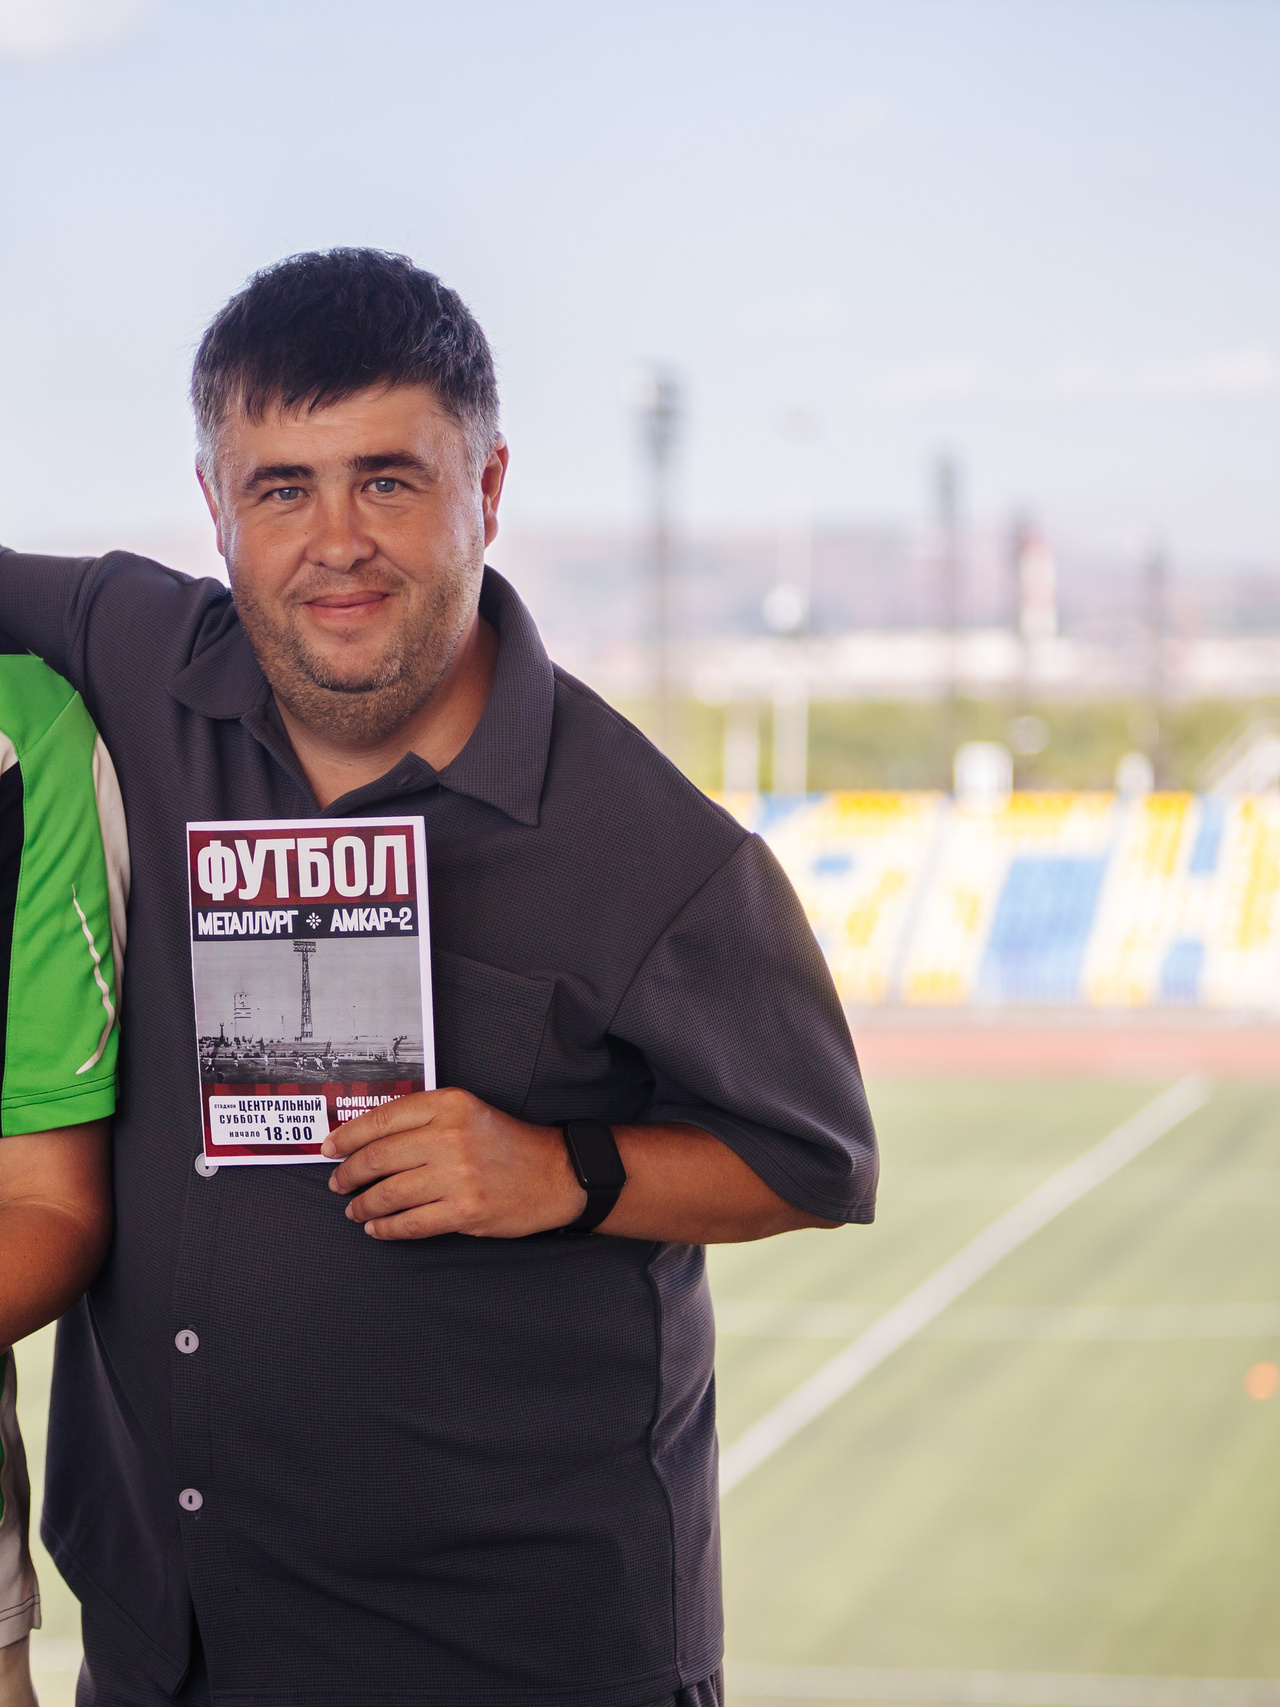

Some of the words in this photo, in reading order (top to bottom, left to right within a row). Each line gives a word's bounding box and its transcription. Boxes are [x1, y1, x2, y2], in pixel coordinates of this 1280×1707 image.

[197, 835, 409, 901] ФУТБОЛ
[197, 910, 299, 936] МЕТАЛЛУРГ
[330, 907, 413, 932] АМКАР-2
[238, 1097, 322, 1113] ЦЕНТРАЛЬНЫЙ
[219, 1114, 266, 1125] СУББОТА
[229, 1130, 261, 1138] начало
[264, 1126, 313, 1141] 18:00
